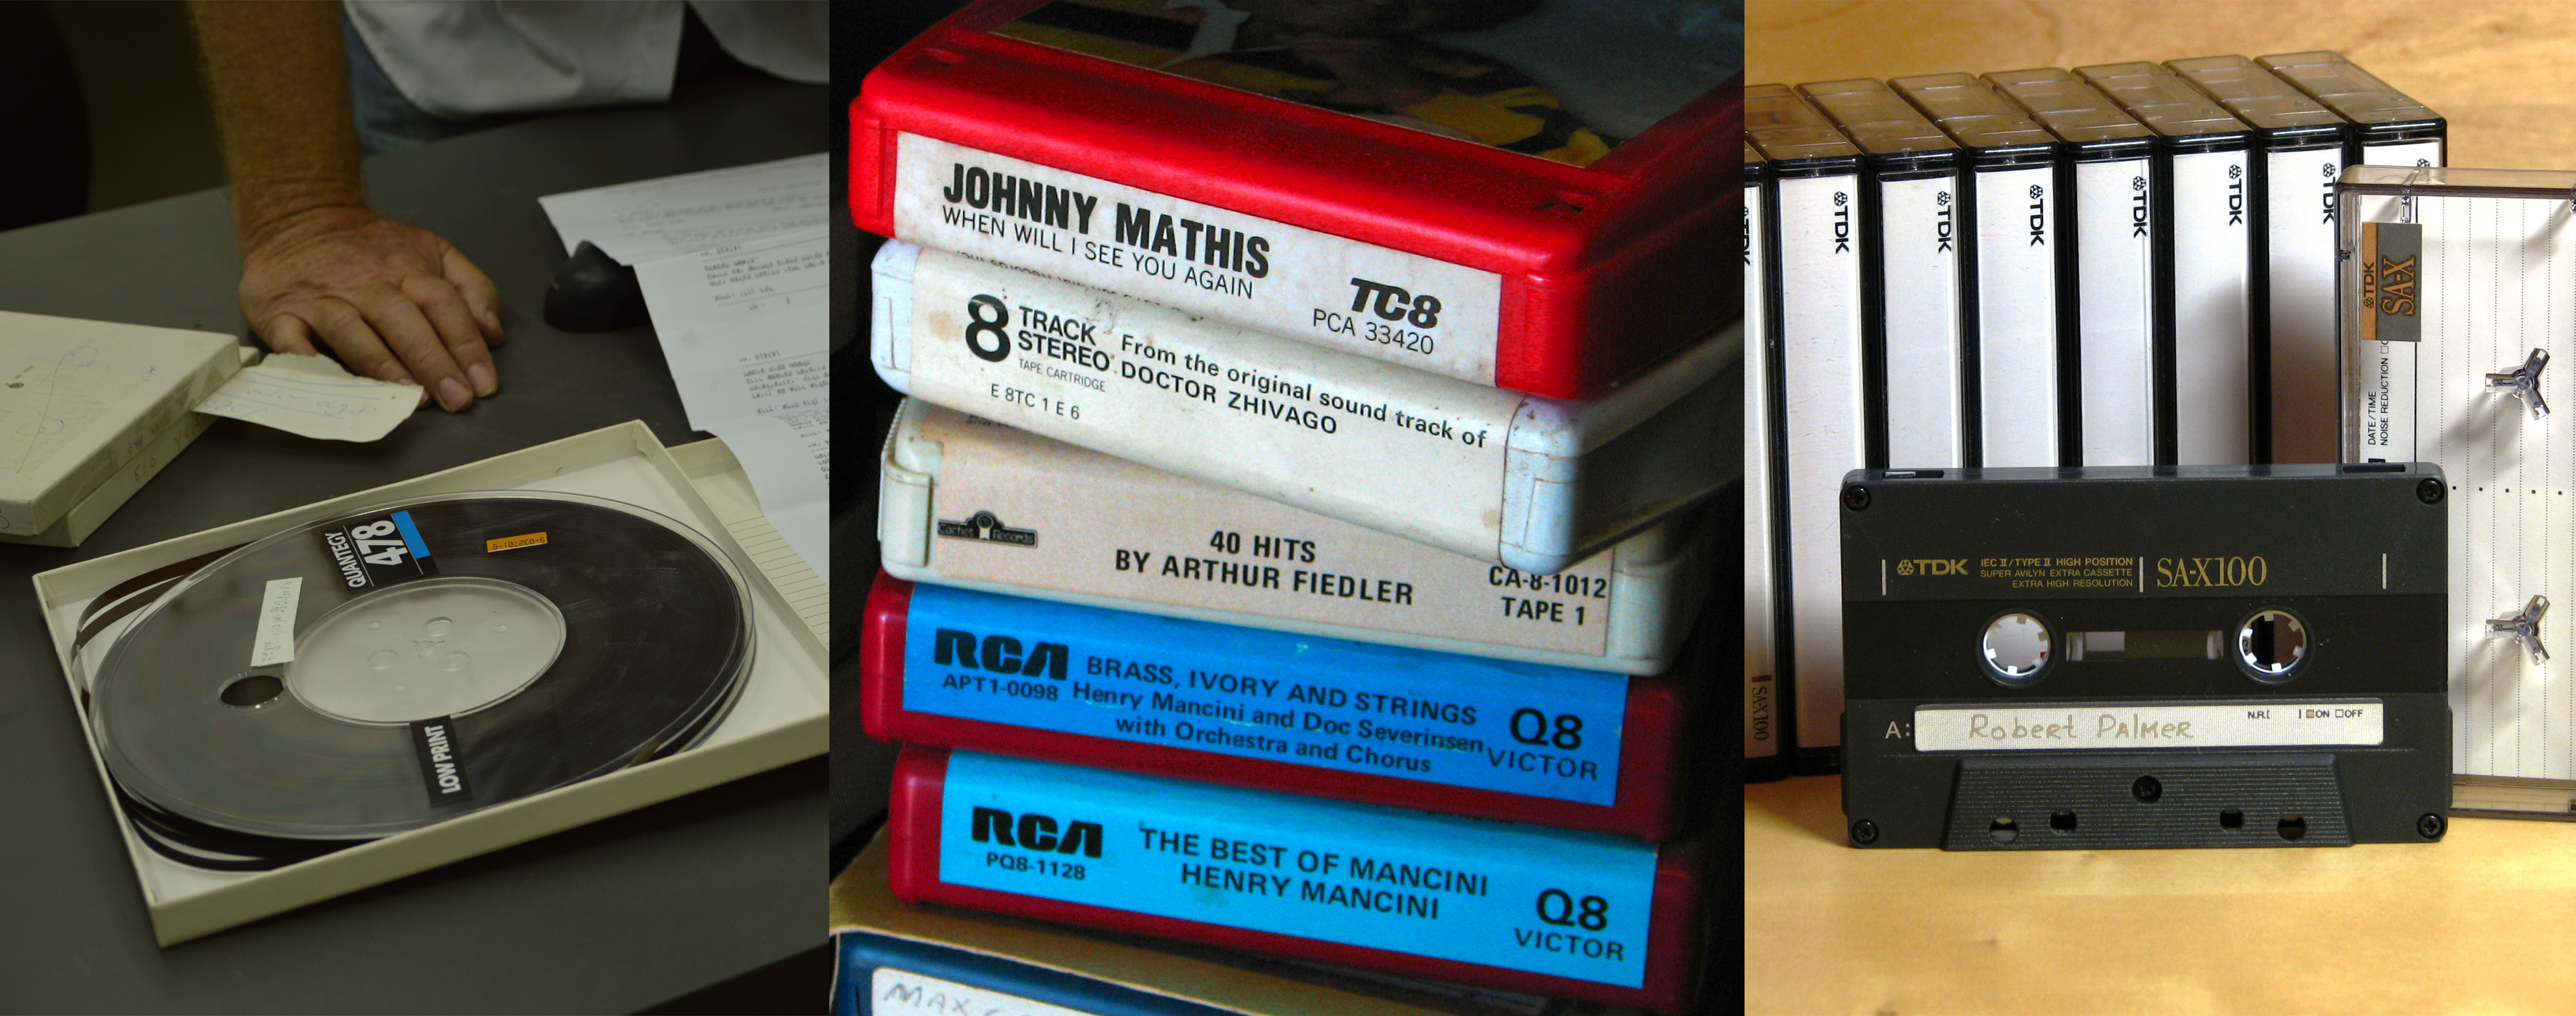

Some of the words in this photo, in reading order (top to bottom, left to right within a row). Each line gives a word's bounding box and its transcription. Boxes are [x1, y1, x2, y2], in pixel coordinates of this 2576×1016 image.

[944, 163, 1097, 235] JOHNNY
[1116, 202, 1270, 278] MATHIS
[2030, 198, 2044, 246] TDK
[2133, 190, 2147, 239] TDK
[2229, 178, 2242, 226] TDK
[2323, 176, 2334, 225] TDK
[942, 205, 1005, 238] WHEN
[1015, 223, 1062, 253] WILL
[1072, 237, 1076, 255] I
[1085, 243, 1123, 268] SEE
[1133, 252, 1176, 280] YOU
[1185, 267, 1253, 299] AGAIN
[1835, 205, 1850, 254] TDK
[1938, 205, 1952, 254] TDK
[2363, 261, 2375, 298] TDK
[2381, 255, 2416, 316] SA-X
[1018, 306, 1096, 346] TRACK
[1350, 278, 1441, 329] TC8
[965, 293, 1010, 363] 8
[1018, 330, 1110, 372] STEREO
[1313, 308, 1355, 337] PCA
[1365, 322, 1434, 355] 33420
[1019, 358, 1042, 375] TAPE
[1046, 366, 1106, 393] CARTRIDGE
[1121, 361, 1216, 404] DOCTOR
[1228, 391, 1337, 434] ZHIVAGO
[1122, 333, 1176, 366] From
[1184, 353, 1219, 377] the
[1227, 368, 1312, 401] original
[1319, 391, 1387, 422] sound
[1395, 410, 1453, 441] track
[1462, 429, 1487, 448] of
[991, 383, 999, 398] E
[1005, 386, 1035, 408] 8TC
[1043, 397, 1048, 411] 1
[1056, 401, 1065, 416] E
[1070, 406, 1080, 421] 6
[2368, 391, 2377, 446] DATE/TIME
[325, 532, 366, 587] QUANTEGY
[351, 520, 409, 567] 478
[493, 537, 545, 549] 9-032701-6
[1211, 530, 1241, 555] 40
[1254, 535, 1317, 563] HITS
[1981, 558, 1997, 567] IEC
[2056, 557, 2081, 567] HIGH
[2084, 557, 2133, 566] POSITION
[1116, 549, 1150, 573] BY
[1162, 555, 1280, 590] ARTHUR
[1292, 570, 1414, 605] FIEDLER
[1489, 566, 1607, 599] CA-8-1012
[1913, 559, 1968, 575] TDK
[1980, 570, 2011, 578] SUPER
[2014, 569, 2046, 577] AVILYN
[2083, 568, 2132, 577] CASSETTE
[2012, 580, 2043, 588] EXTRA
[2046, 579, 2069, 587] HIGH
[2073, 579, 2133, 587] RESOLUTION
[2156, 555, 2268, 587] SA-X100
[1501, 596, 1564, 622] TAPE
[1576, 606, 1585, 625] 1
[934, 627, 1069, 680] RCA
[942, 674, 1058, 702] APT1-0098
[1087, 656, 1181, 689] BRASS,
[1189, 669, 1279, 698] IVORY
[1288, 684, 1347, 708] AND
[1355, 693, 1477, 726] STRINGS
[1073, 681, 1143, 711] Henry
[1152, 692, 1244, 723] Mancini
[1252, 710, 1294, 729] and
[1304, 713, 1351, 736] Doc
[1357, 719, 1483, 753] Severinsen
[1510, 707, 1584, 751] Q8
[1752, 686, 1769, 741] SA-X100
[425, 725, 452, 762] PRINT
[1116, 718, 1166, 737] with
[1175, 722, 1287, 753] Orchestra
[1296, 742, 1339, 761] and
[1346, 744, 1430, 773] Chorus
[1488, 748, 1598, 781] VICTOR
[435, 763, 462, 794] LOW
[971, 806, 1103, 859] RCA
[986, 851, 1085, 881] PQ8-1128
[1139, 827, 1199, 856] THE
[1211, 838, 1287, 869] BEST
[1297, 851, 1340, 876] OF
[1350, 857, 1488, 897] MANCINI
[1181, 863, 1291, 897] HENRY
[1302, 881, 1438, 919] MANCINI
[1536, 889, 1609, 932] Q8
[1514, 927, 1624, 962] VICTOR
